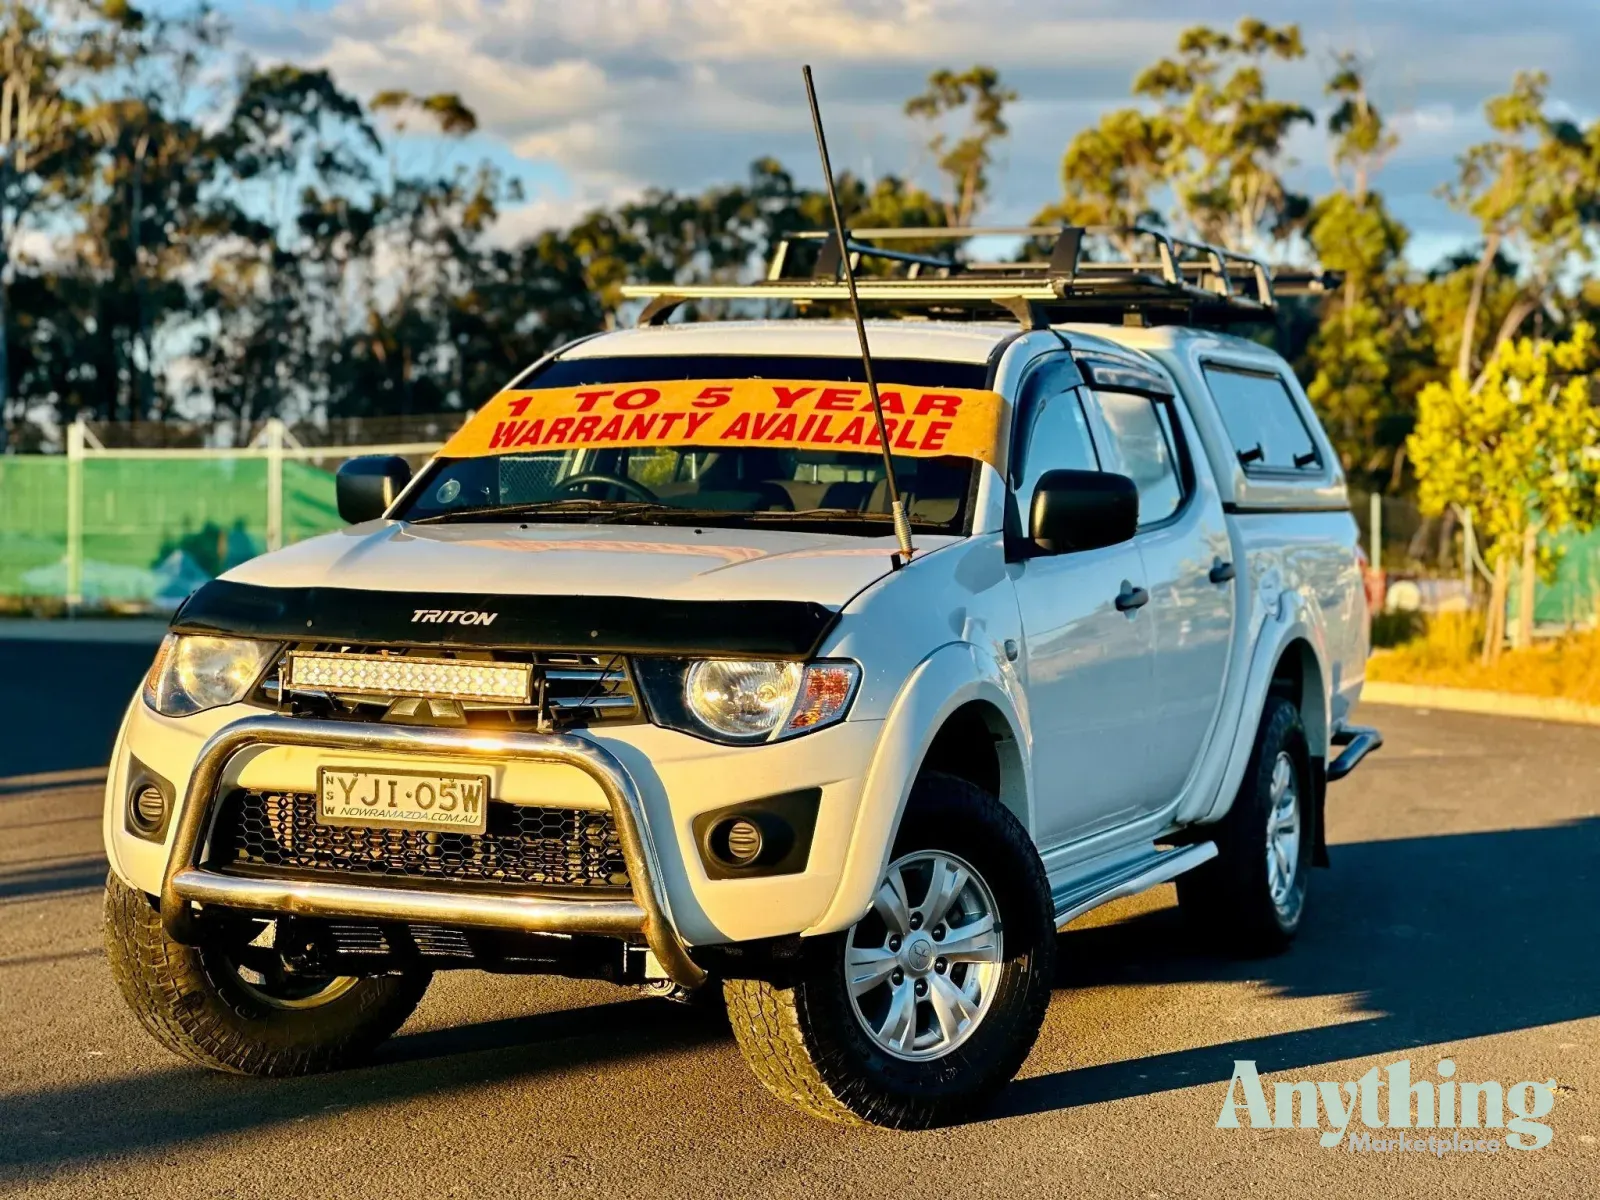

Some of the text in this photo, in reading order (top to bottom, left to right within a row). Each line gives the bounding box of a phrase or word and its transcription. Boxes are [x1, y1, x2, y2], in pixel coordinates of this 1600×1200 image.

[508, 386, 963, 417] 1 TO 5 YEAR
[488, 412, 953, 451] WARRANTY AVAILABLE
[411, 609, 498, 626] TRITON
[340, 807, 479, 824] NOWRAMAZDA.COM.AU
